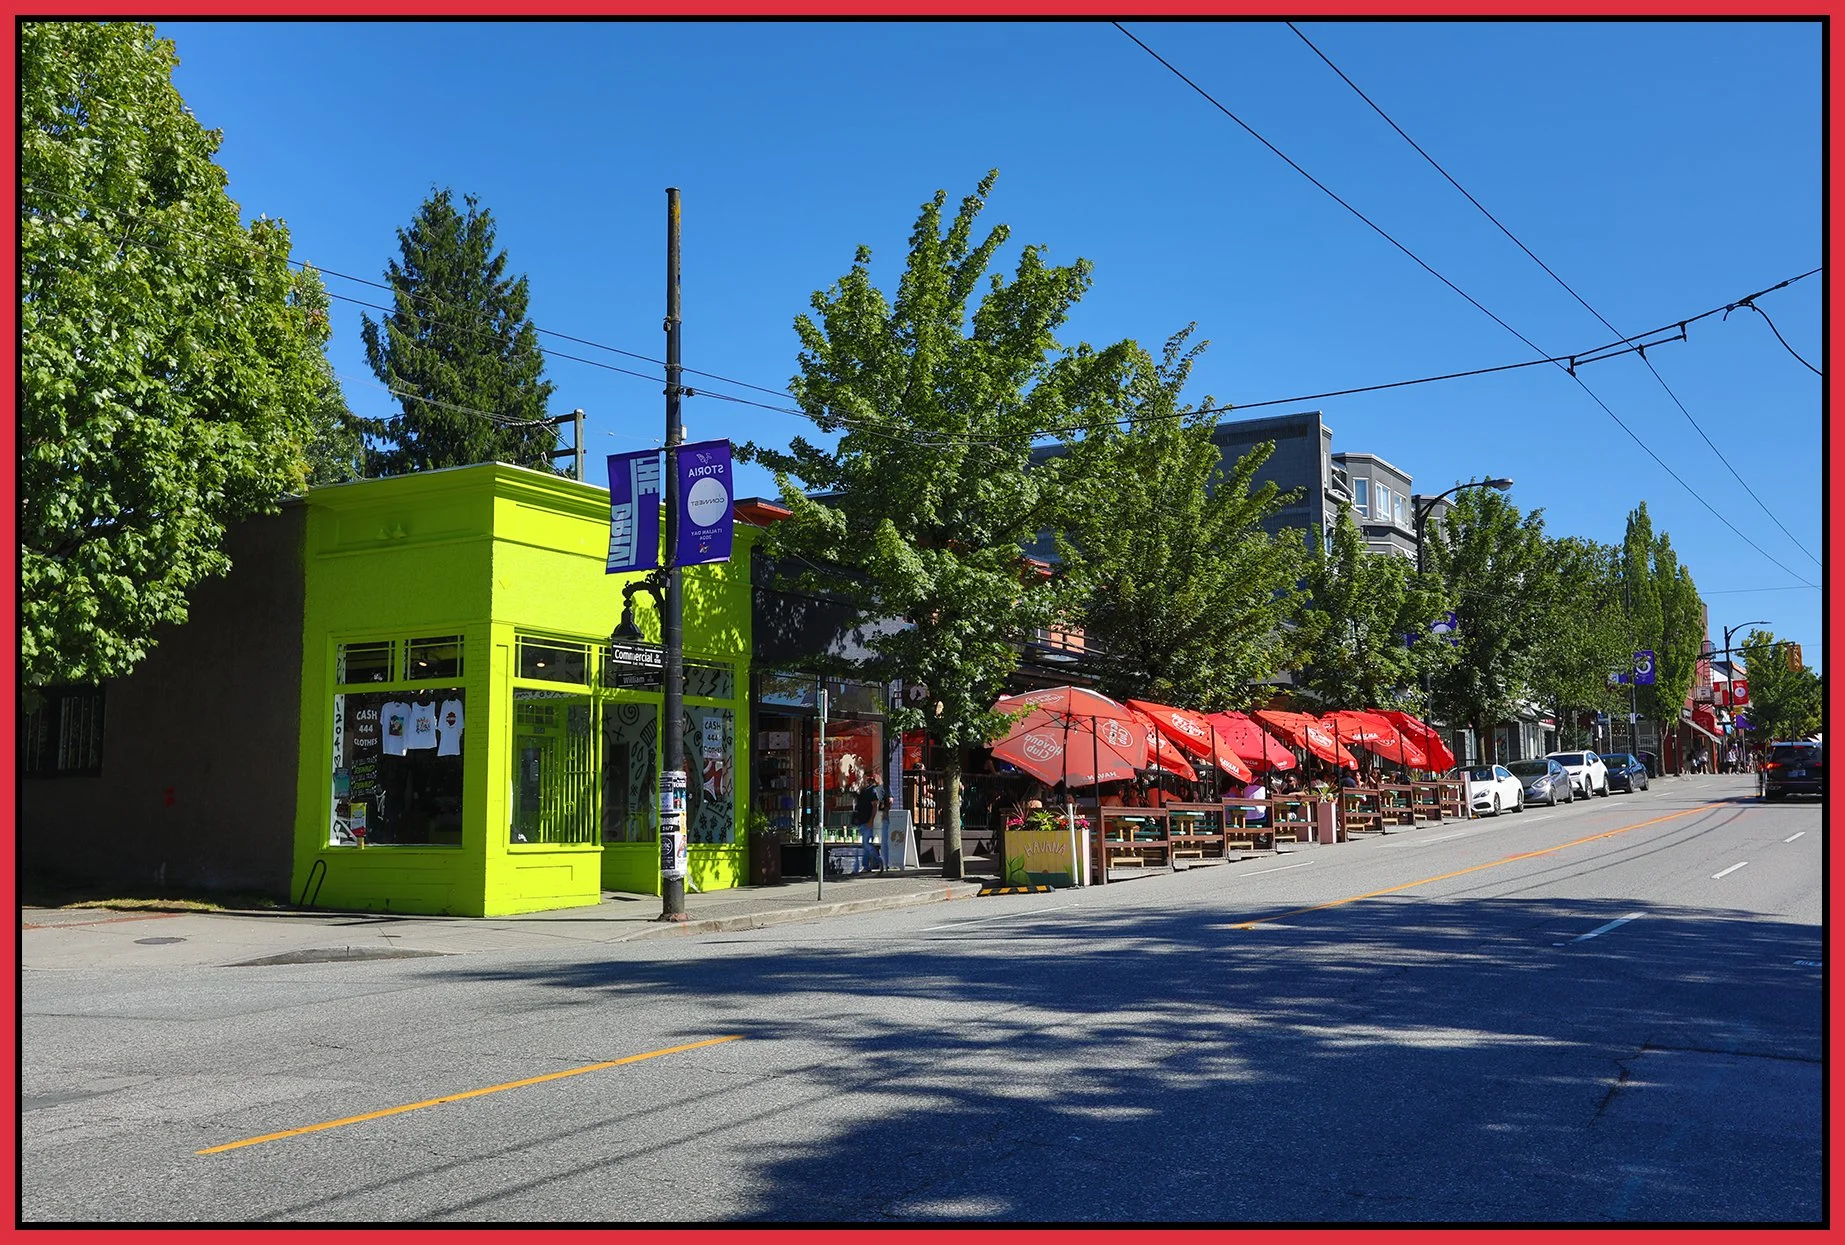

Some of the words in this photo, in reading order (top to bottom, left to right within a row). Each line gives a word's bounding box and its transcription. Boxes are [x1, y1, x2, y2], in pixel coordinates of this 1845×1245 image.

[614, 649, 653, 663] Commercial
[622, 675, 645, 684] William
[356, 710, 378, 720] CASH
[358, 724, 374, 733] 444
[704, 721, 721, 730] CASH
[353, 737, 378, 747] CLOTHES
[1023, 841, 1068, 857] HAVANA
